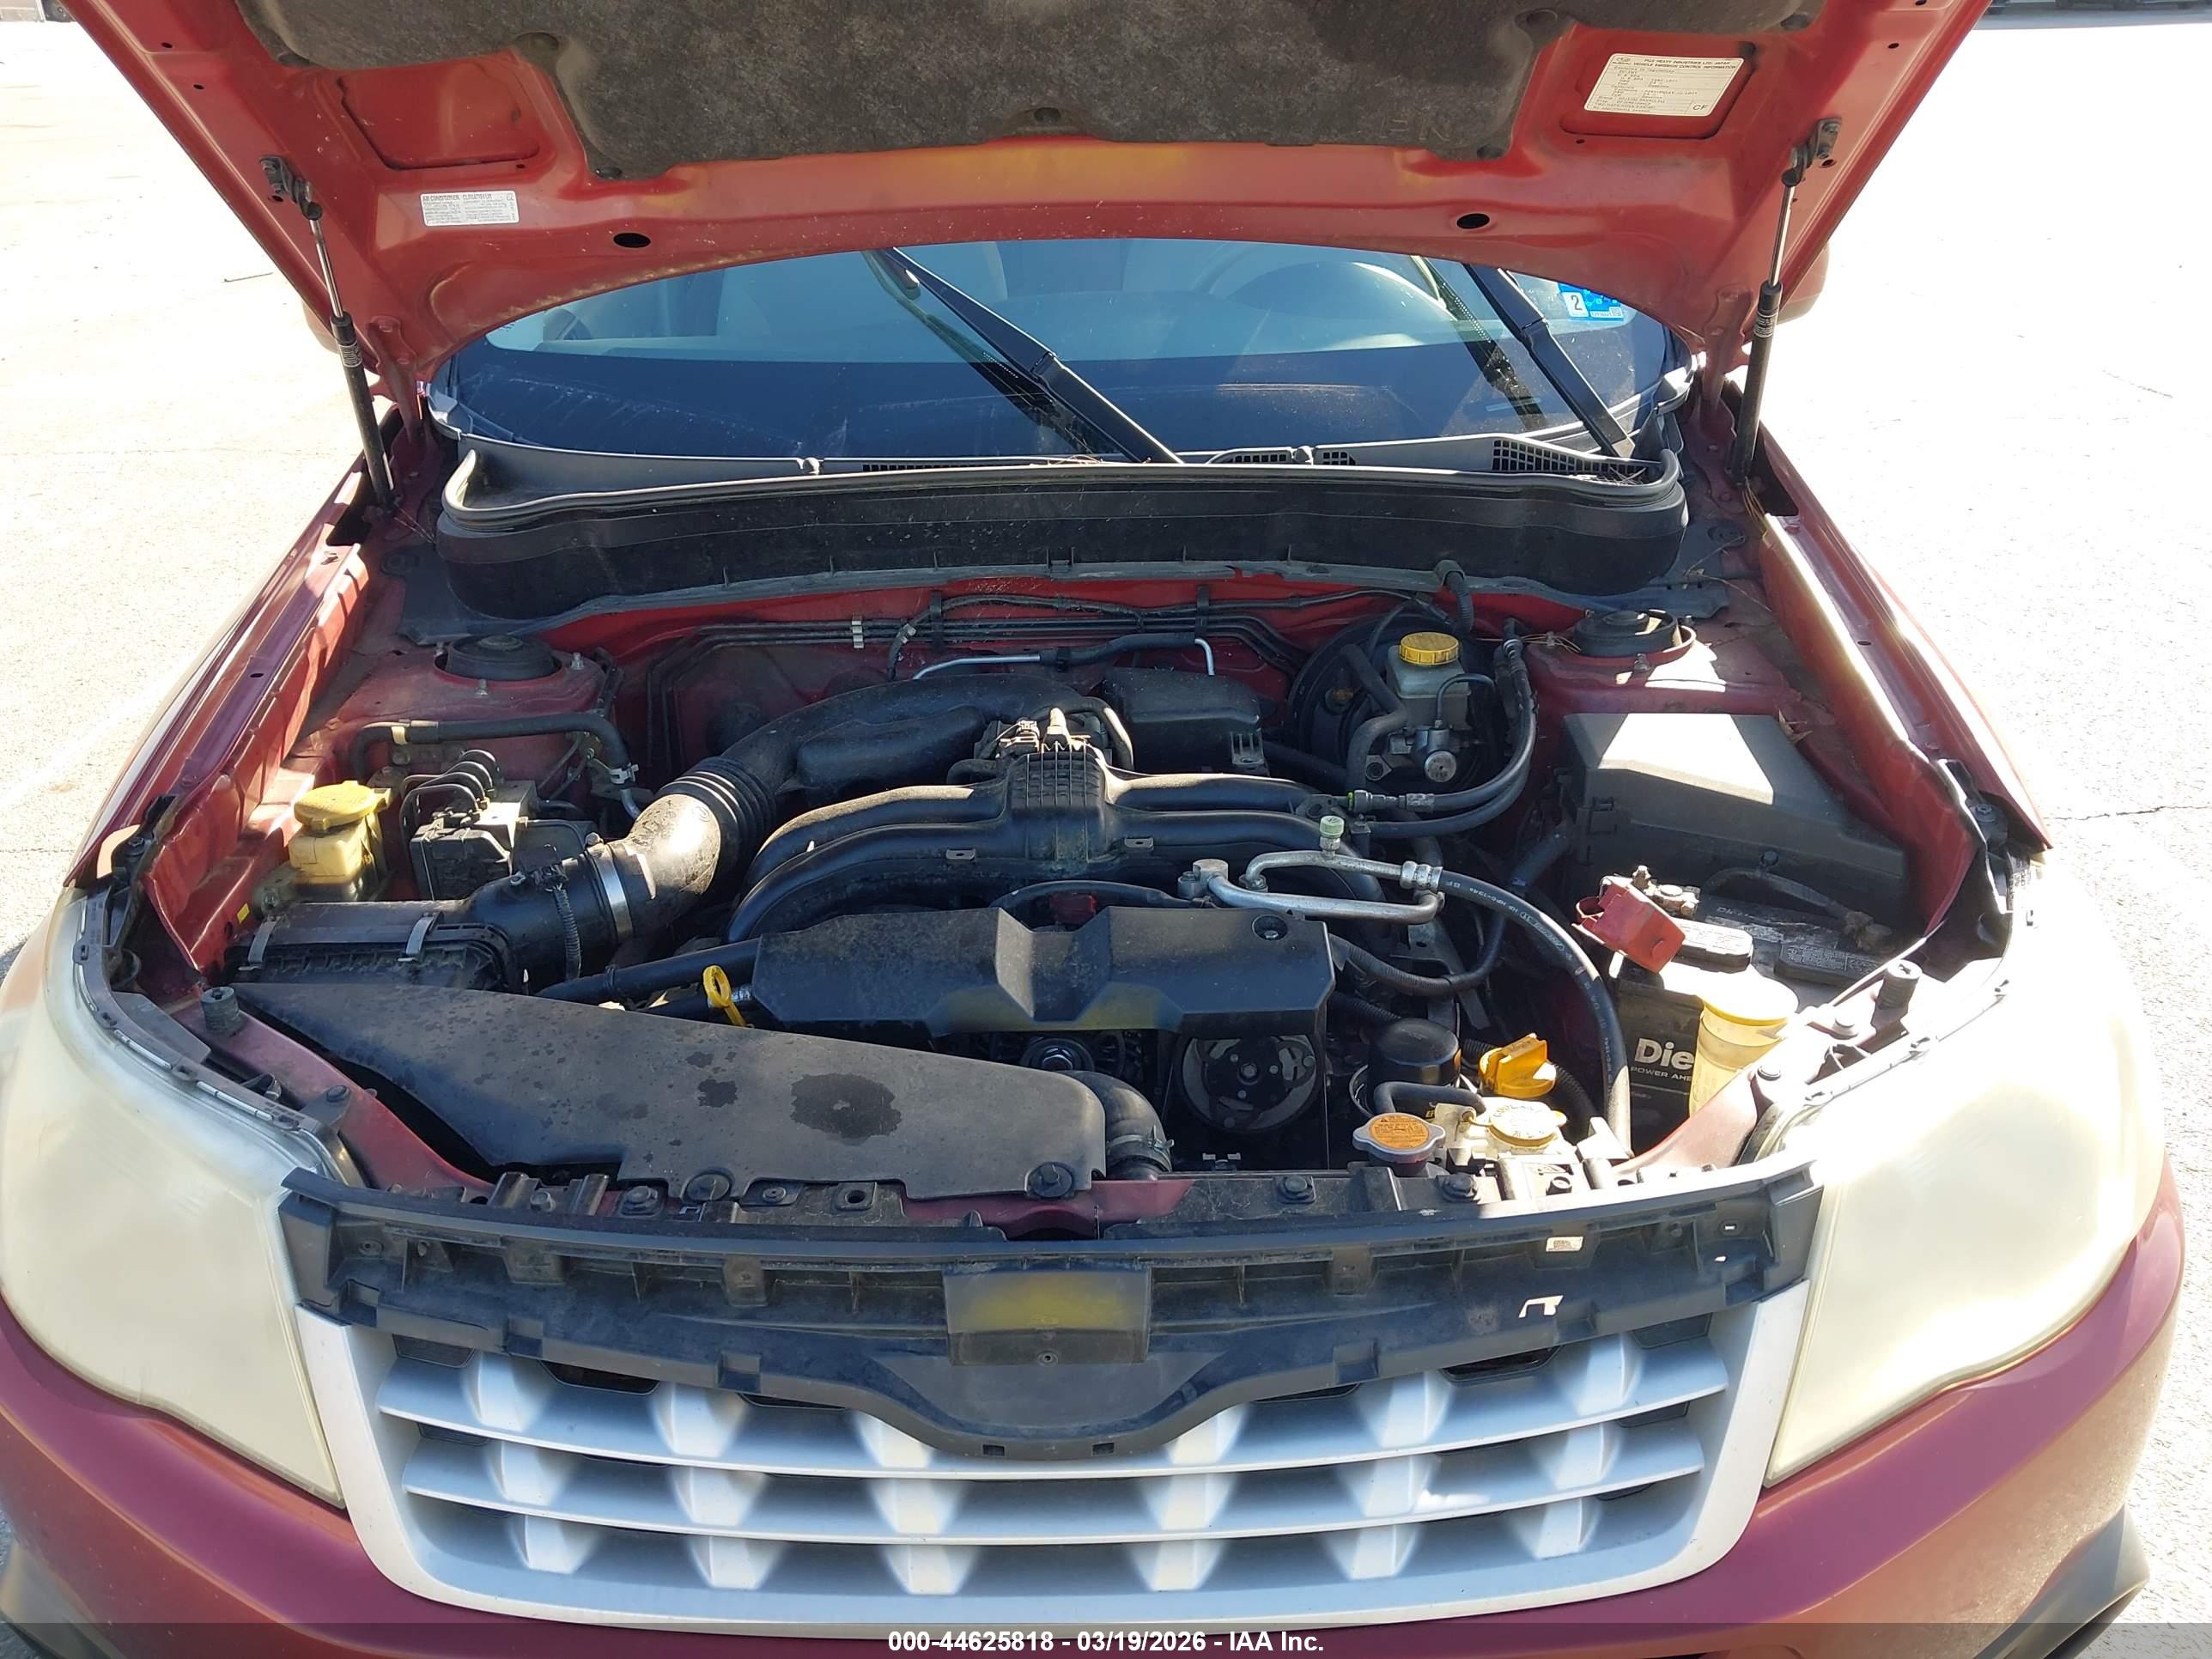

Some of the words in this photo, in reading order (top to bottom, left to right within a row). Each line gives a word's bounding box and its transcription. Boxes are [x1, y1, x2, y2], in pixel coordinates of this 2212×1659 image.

[1571, 295, 1583, 311] 2
[1634, 1037, 1694, 1070] Die
[1631, 1066, 1668, 1078] POWER
